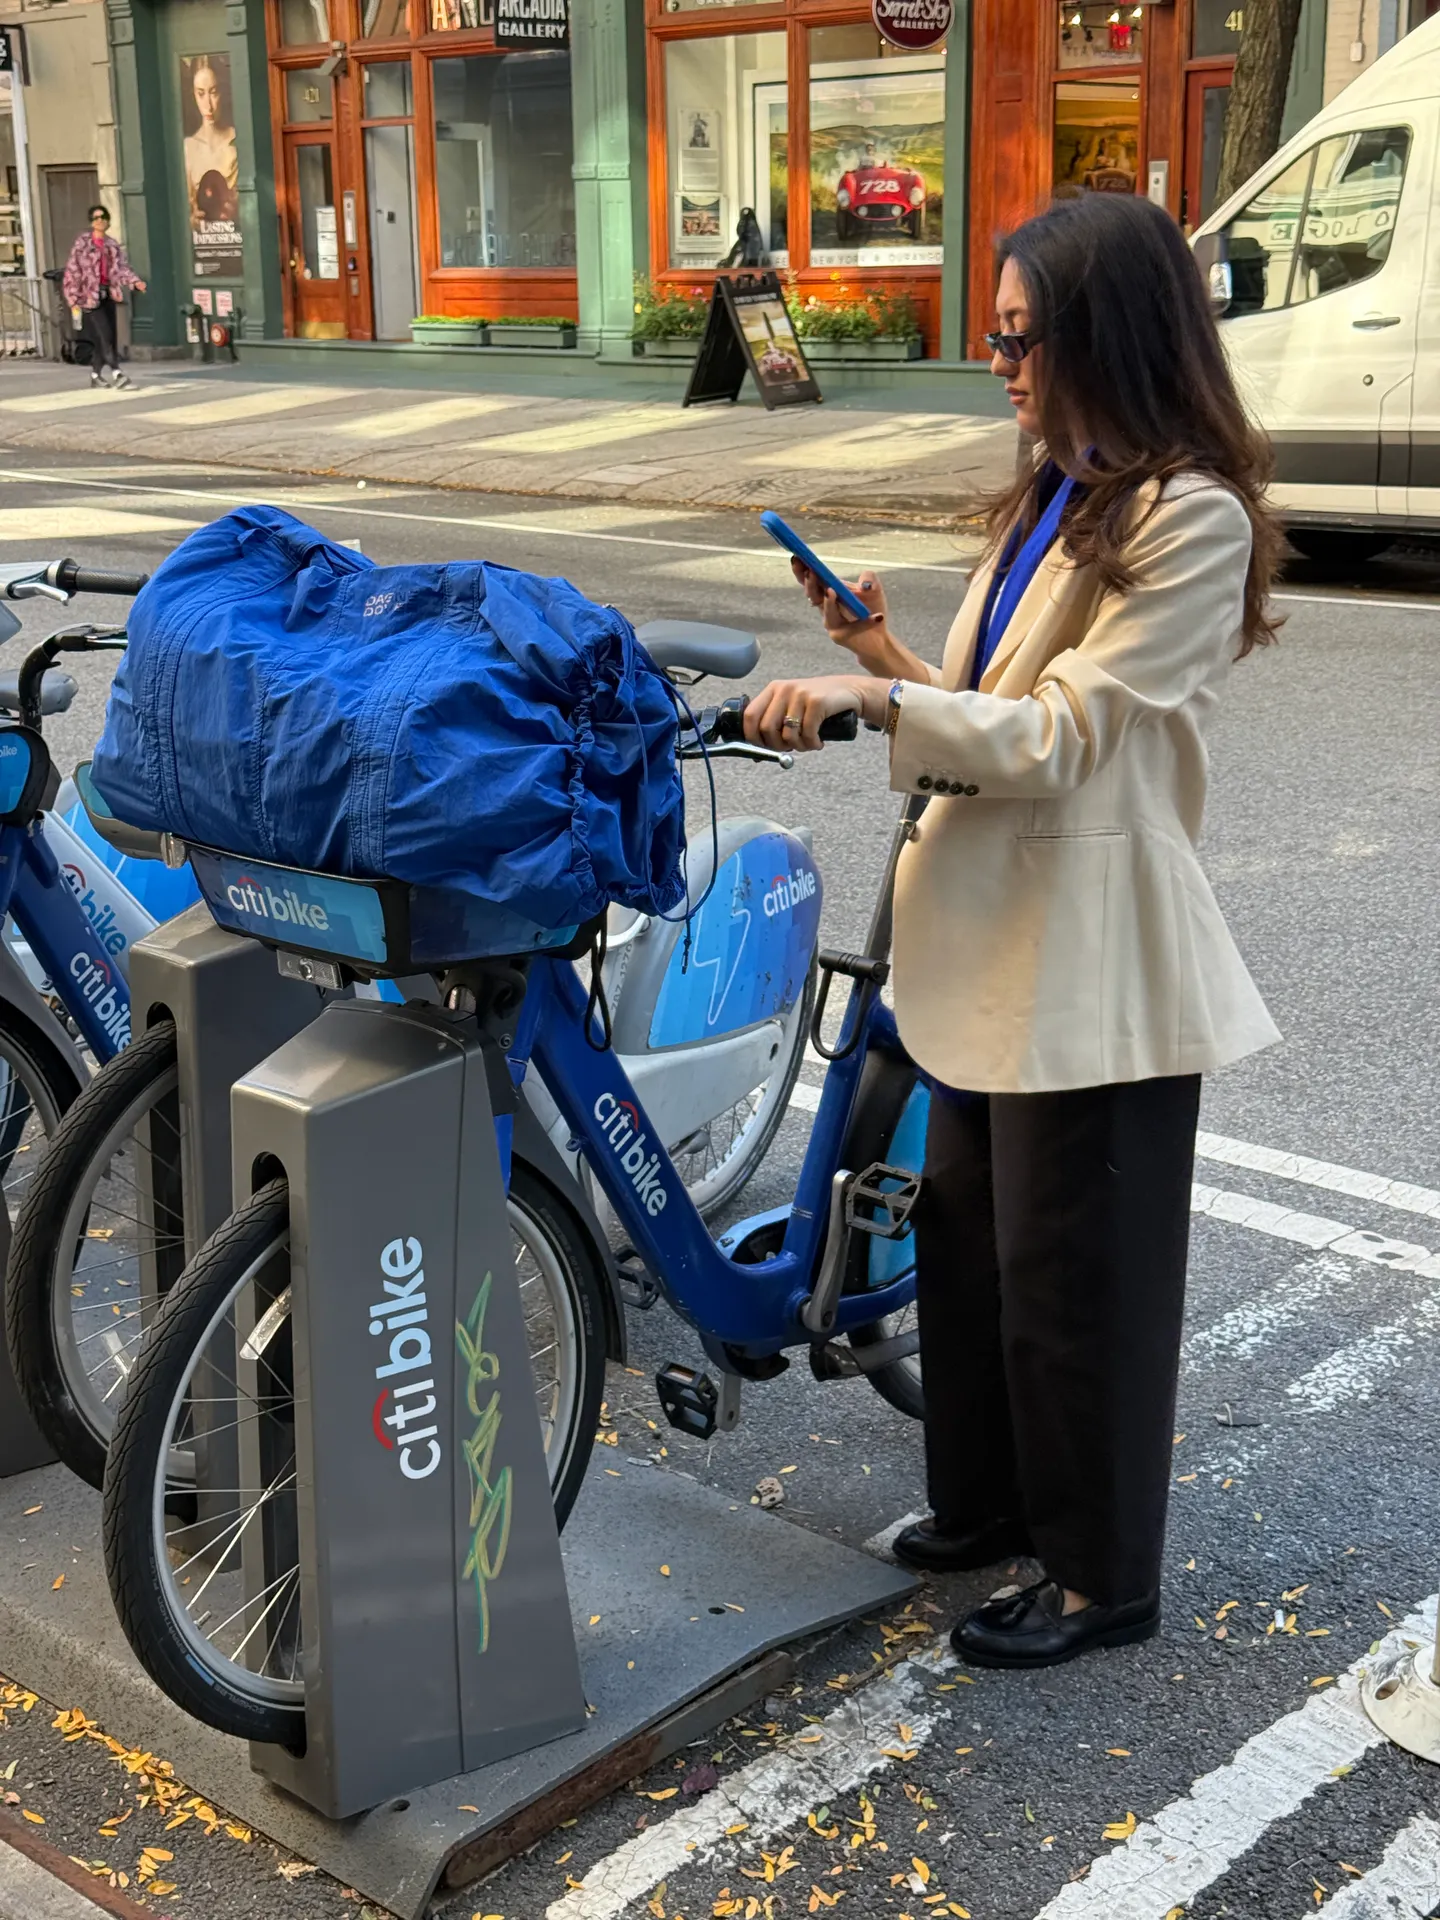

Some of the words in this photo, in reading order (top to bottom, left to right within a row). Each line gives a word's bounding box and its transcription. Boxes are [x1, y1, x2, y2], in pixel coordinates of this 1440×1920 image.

[498, 0, 566, 20] ARCADIA
[498, 22, 566, 38] GALLERY
[859, 180, 900, 195] 728
